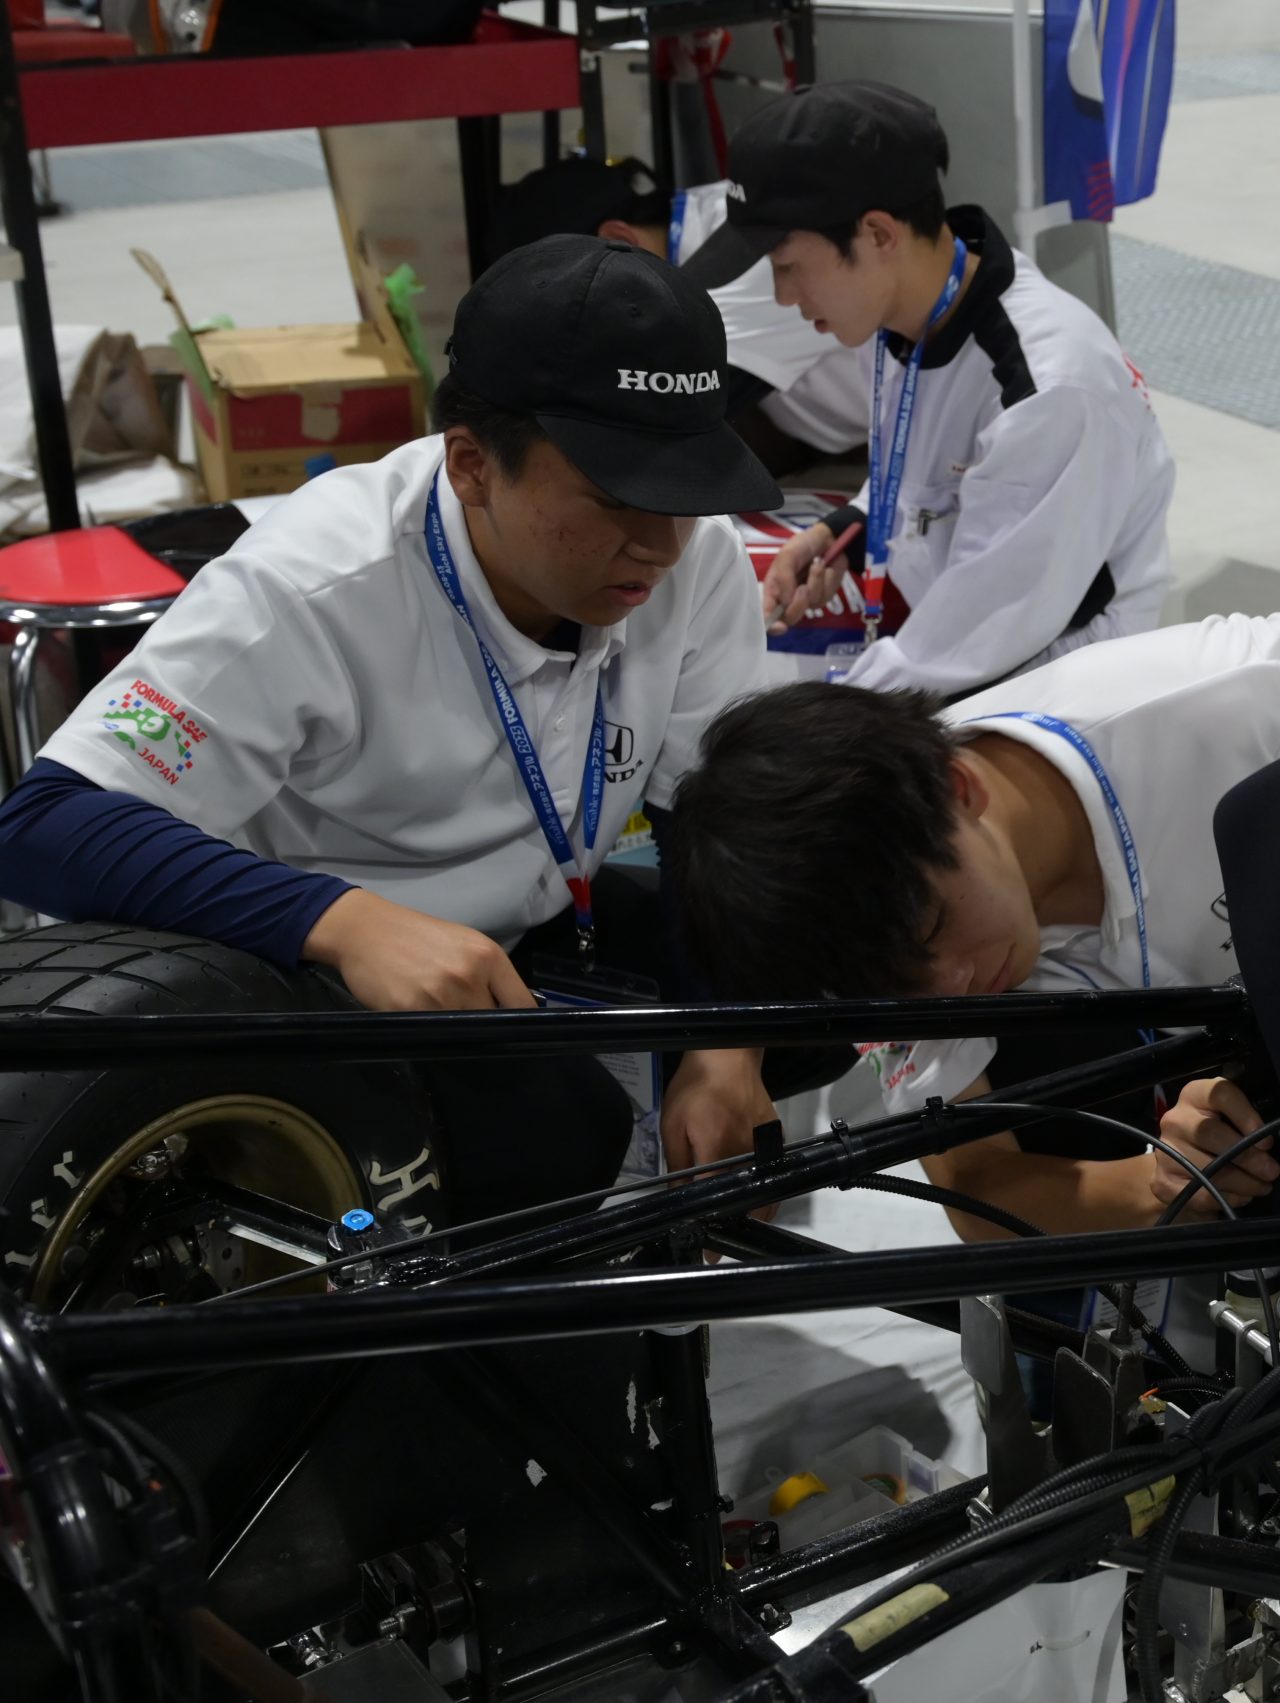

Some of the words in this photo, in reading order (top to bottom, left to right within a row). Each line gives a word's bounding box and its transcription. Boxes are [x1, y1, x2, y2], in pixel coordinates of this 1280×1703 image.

[617, 369, 720, 394] HONDA
[431, 512, 441, 535] Expo
[436, 536, 446, 554] Sky
[130, 680, 186, 724] FORMULA
[182, 719, 208, 744] SAE
[490, 669, 518, 725] FORMULA
[510, 725, 533, 754] 2025
[137, 747, 180, 786] JAPAN
[1115, 806, 1135, 849] JAPAN
